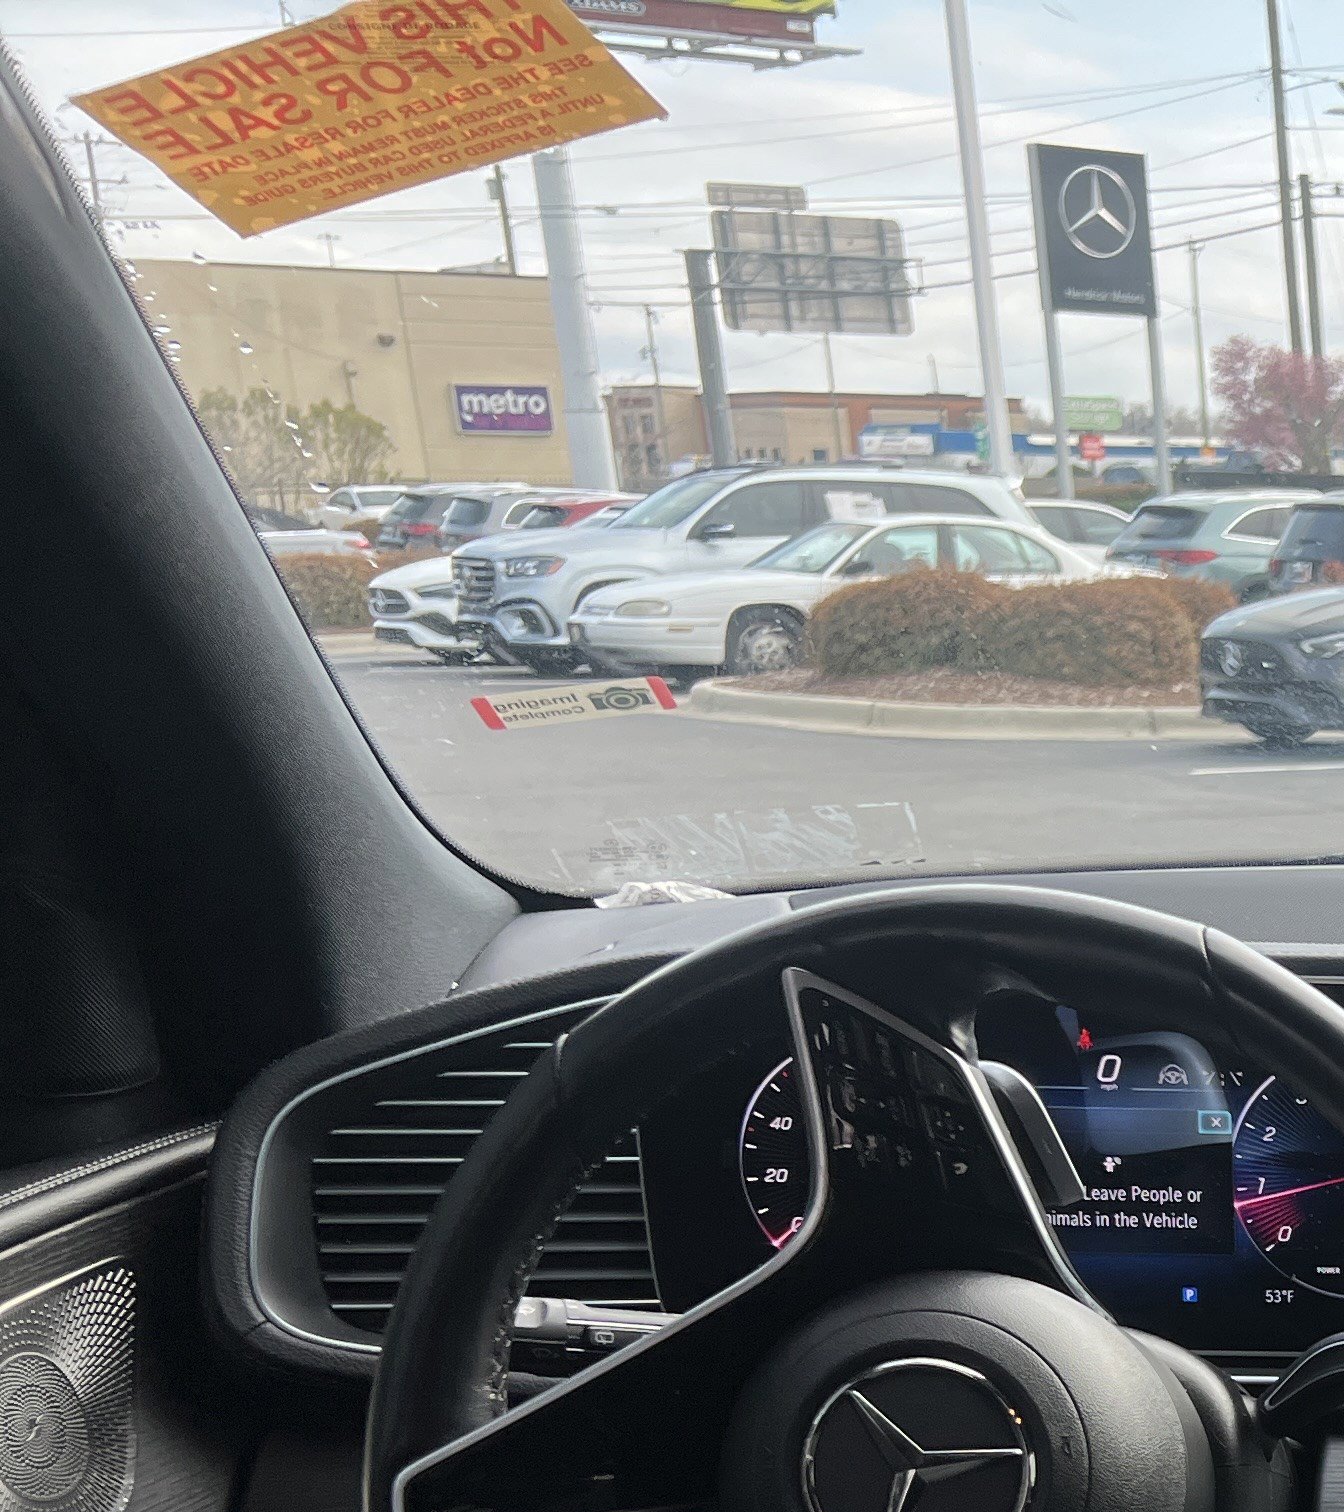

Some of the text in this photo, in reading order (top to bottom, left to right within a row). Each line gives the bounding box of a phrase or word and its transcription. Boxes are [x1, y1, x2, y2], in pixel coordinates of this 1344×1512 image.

[461, 388, 547, 416] metro
[1096, 1054, 1121, 1083] 0
[769, 1116, 793, 1131] 40
[1262, 1126, 1277, 1142] 2
[763, 1168, 789, 1183] 20
[1257, 1176, 1266, 1195] 1
[1084, 1186, 1202, 1204] Leave People or
[1095, 1211, 1110, 1228] in
[1113, 1211, 1139, 1229] the
[1142, 1212, 1198, 1229] Vehicle
[1277, 1225, 1293, 1242] 0
[1316, 1266, 1341, 1275] POWER
[1265, 1289, 1295, 1303] 53°F
